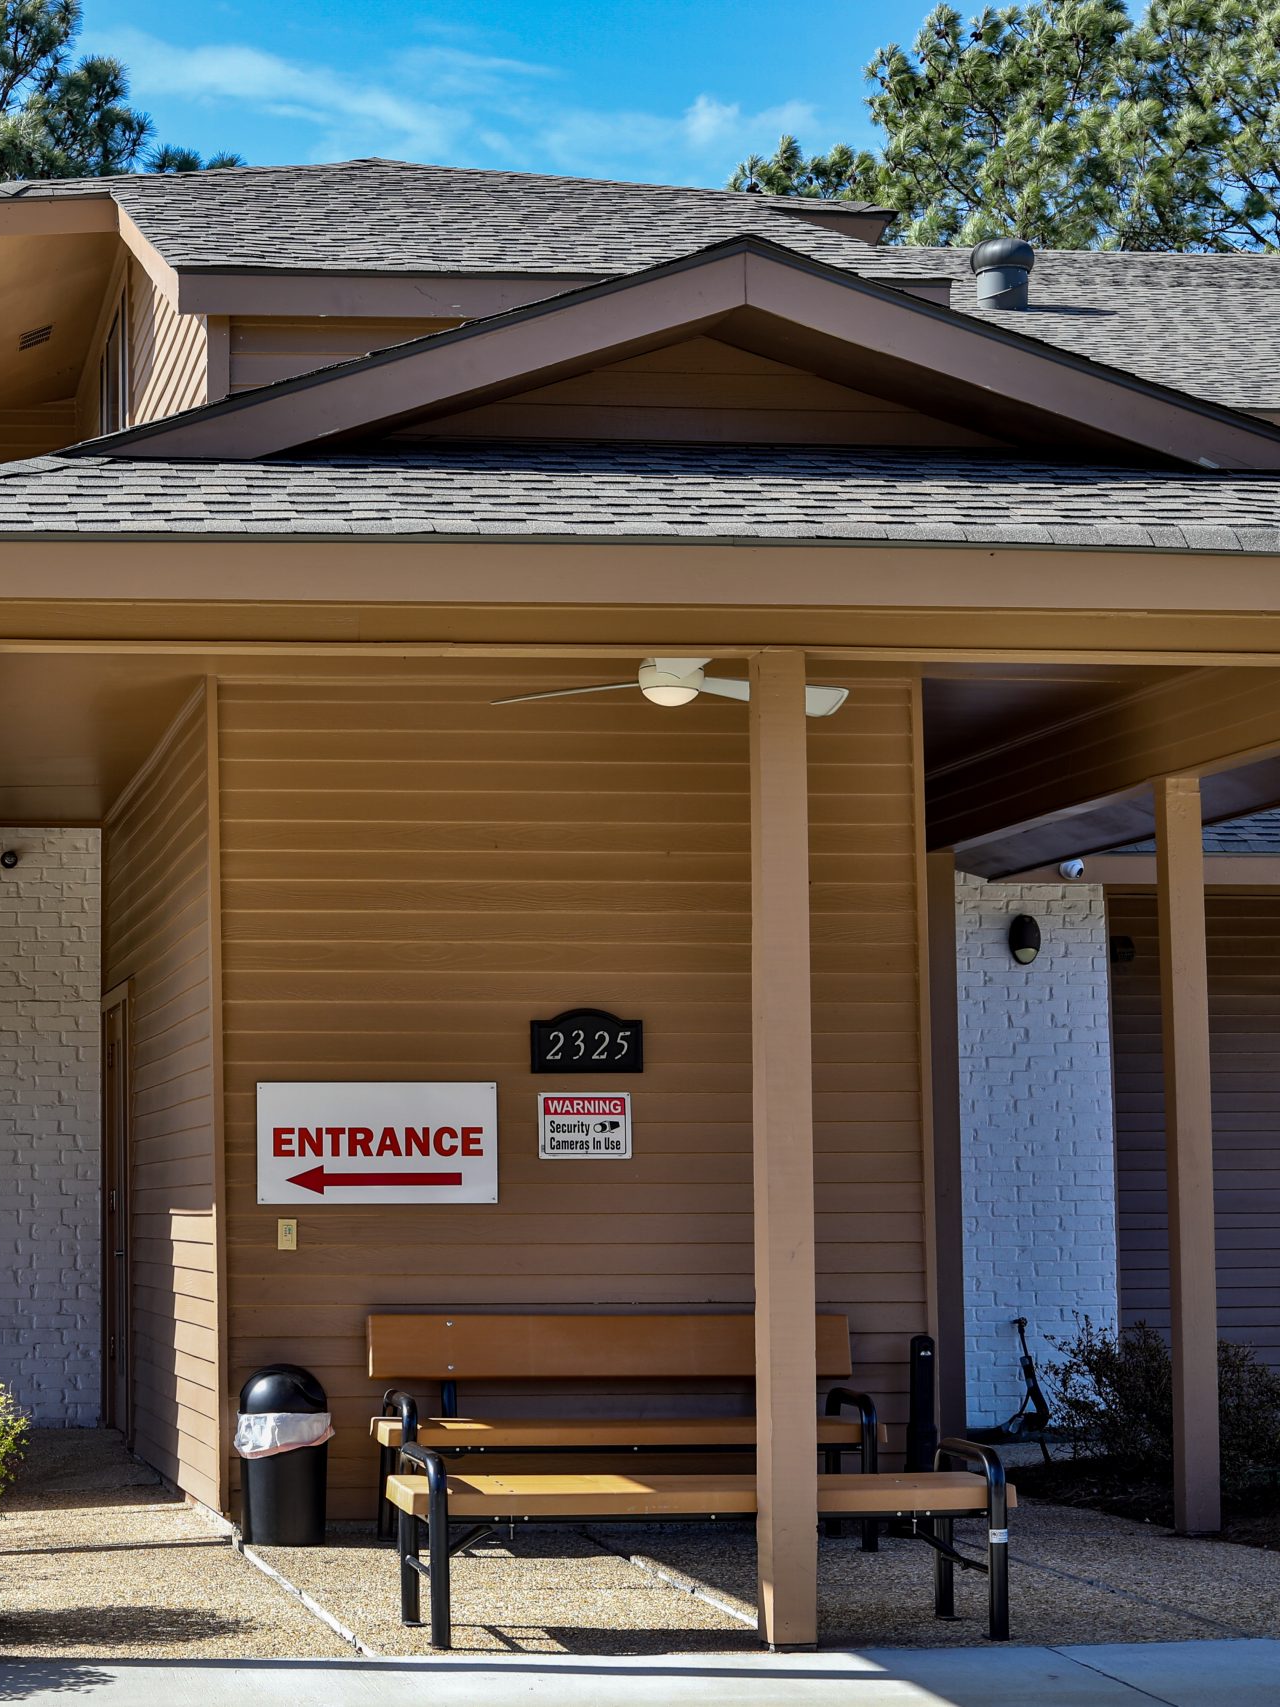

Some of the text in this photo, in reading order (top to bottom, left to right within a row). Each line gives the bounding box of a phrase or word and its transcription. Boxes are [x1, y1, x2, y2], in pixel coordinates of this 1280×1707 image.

[546, 1030, 631, 1060] 2325
[548, 1100, 622, 1113] WARNING
[550, 1120, 590, 1136] Security
[273, 1126, 484, 1157] ENTRANCE
[550, 1137, 590, 1150] Cameras
[593, 1137, 601, 1150] In
[604, 1137, 621, 1150] Use
